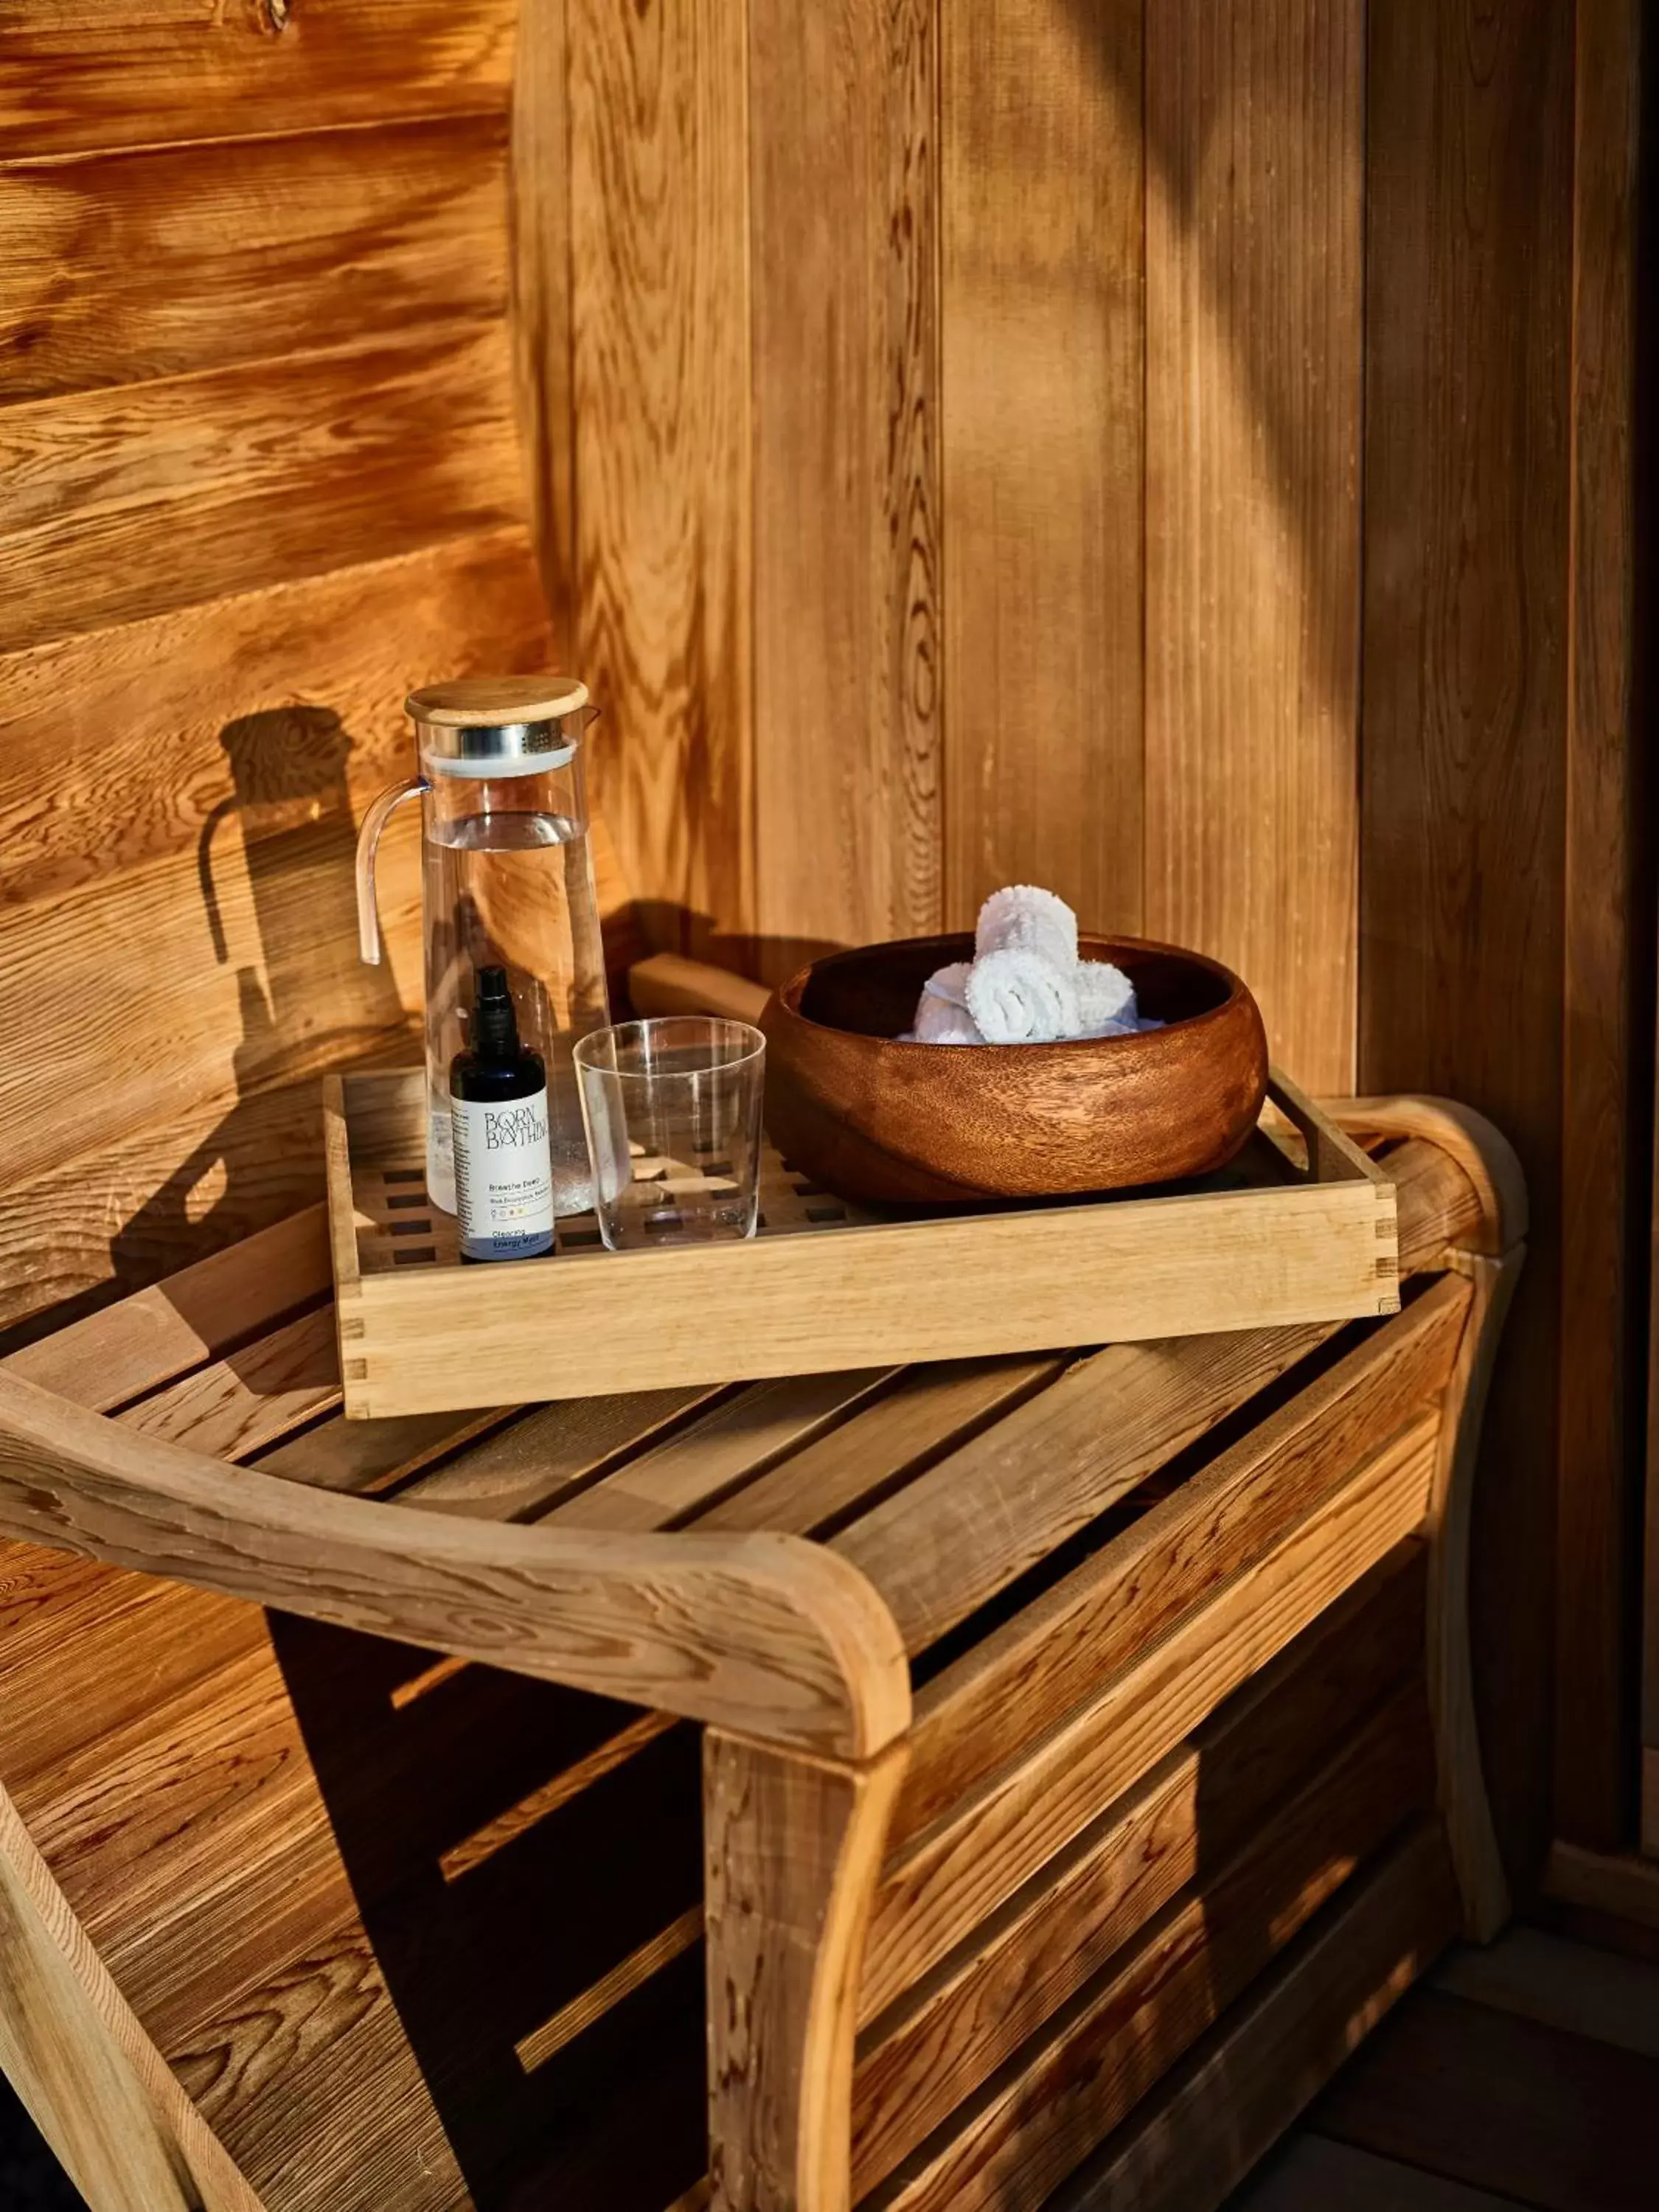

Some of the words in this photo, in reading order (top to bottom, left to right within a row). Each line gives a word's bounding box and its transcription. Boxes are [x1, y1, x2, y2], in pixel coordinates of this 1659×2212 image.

[484, 1105, 535, 1133] BORN
[487, 1119, 547, 1150] BATHIN
[489, 1183, 521, 1192] Breathe
[523, 1178, 540, 1188] Deep
[492, 1229, 526, 1237] Clearing
[493, 1239, 521, 1248] Energy
